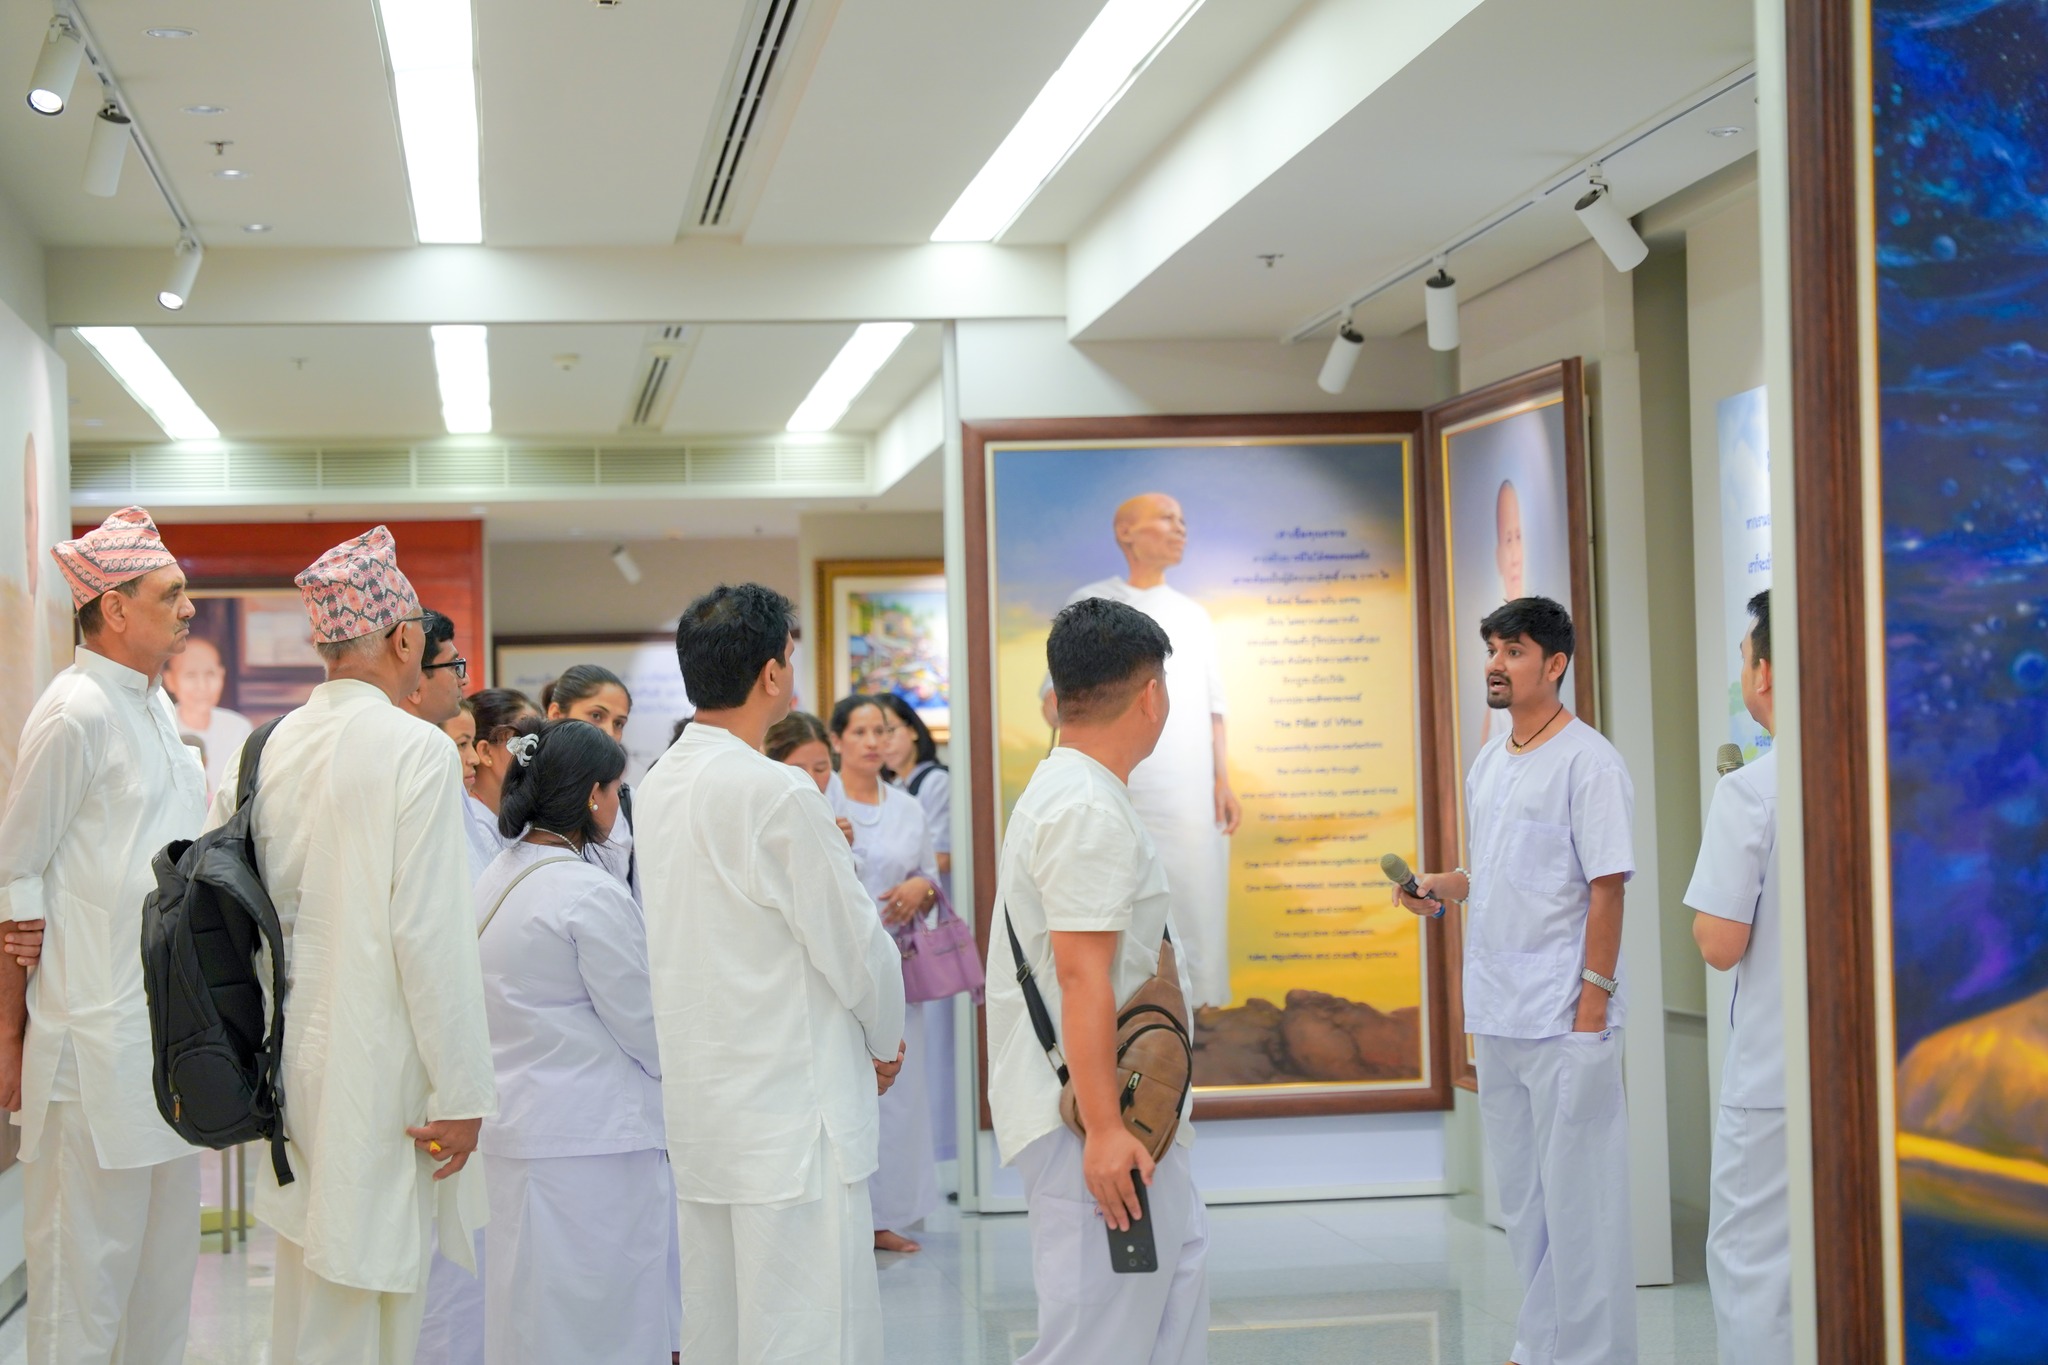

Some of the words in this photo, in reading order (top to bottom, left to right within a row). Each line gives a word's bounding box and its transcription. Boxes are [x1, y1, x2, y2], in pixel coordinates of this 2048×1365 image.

[1273, 717, 1292, 728] The
[1294, 716, 1318, 728] Pillar
[1322, 716, 1331, 728] of
[1334, 716, 1364, 728] Virtue
[1273, 928, 1289, 939] One
[1292, 929, 1311, 939] must
[1271, 950, 1313, 963] regulations
[1315, 950, 1330, 961] and
